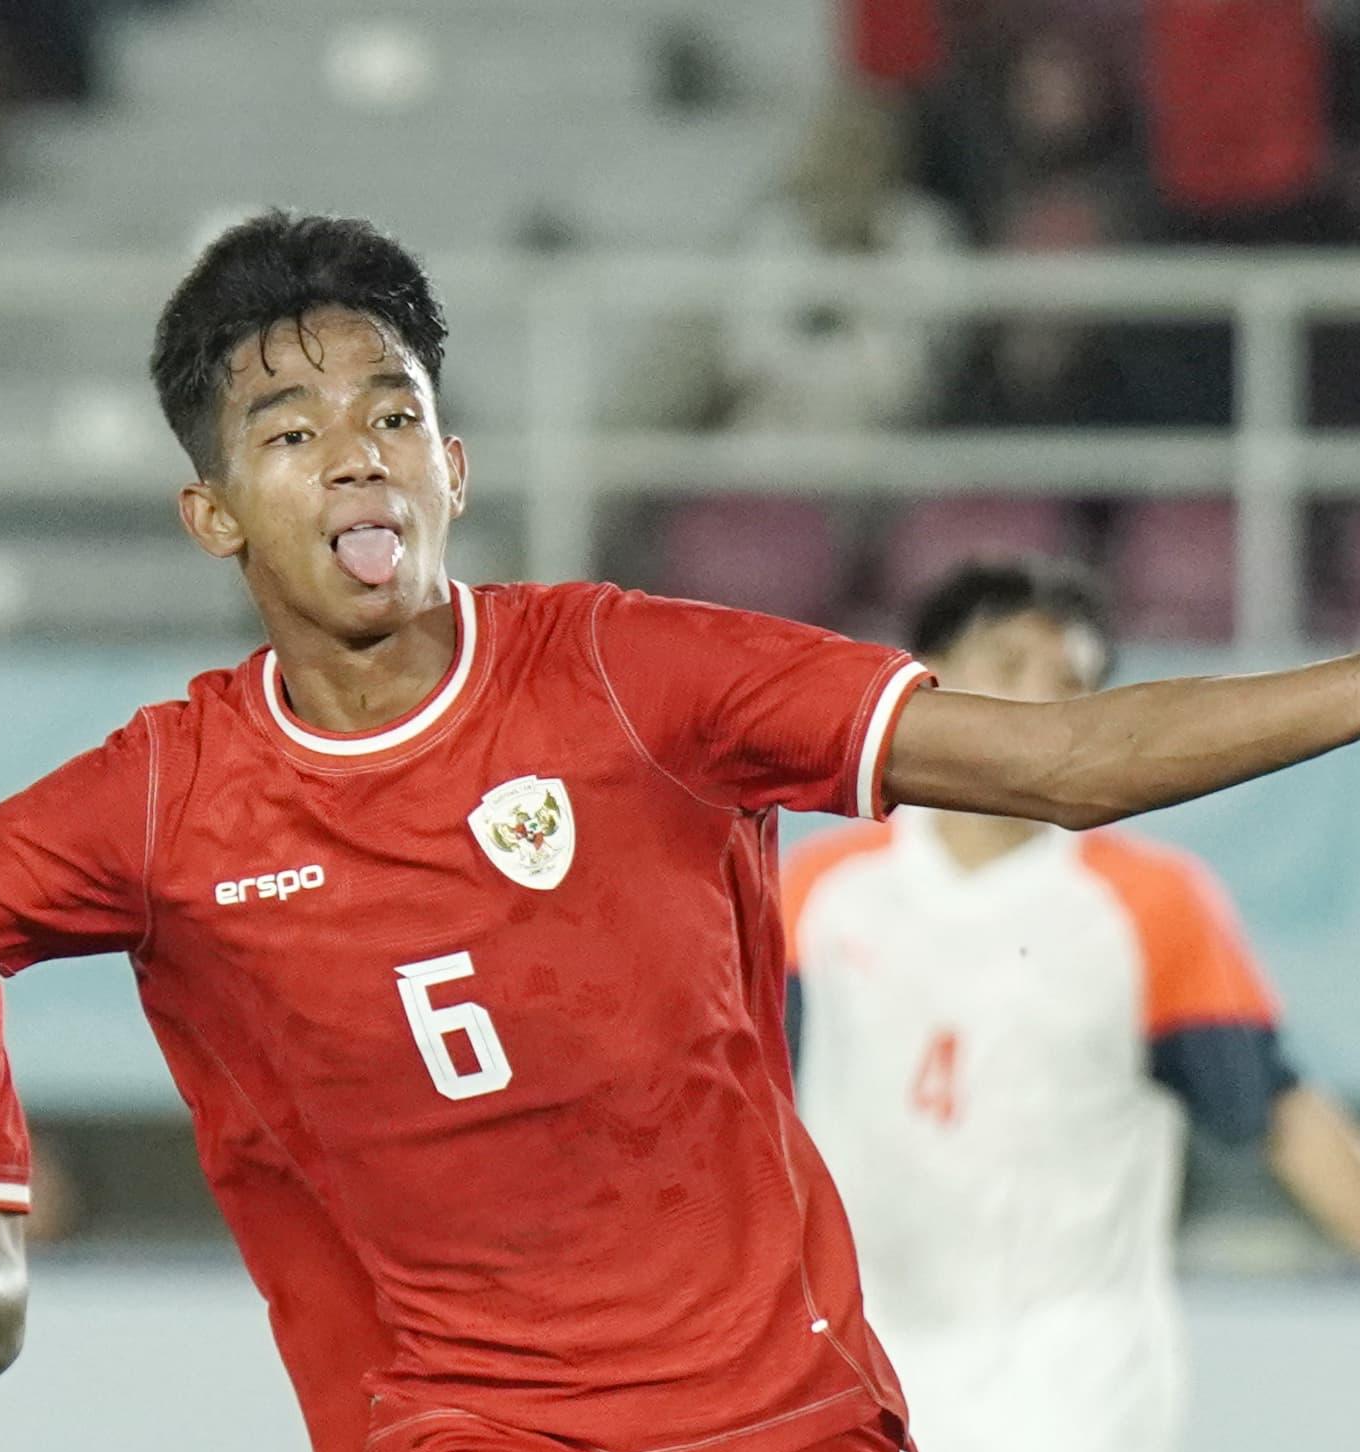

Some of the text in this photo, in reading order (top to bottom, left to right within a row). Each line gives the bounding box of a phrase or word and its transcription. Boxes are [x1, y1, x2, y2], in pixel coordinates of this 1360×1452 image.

[214, 863, 325, 905] erspo
[393, 950, 514, 1101] 6
[908, 1022, 961, 1133] 4
